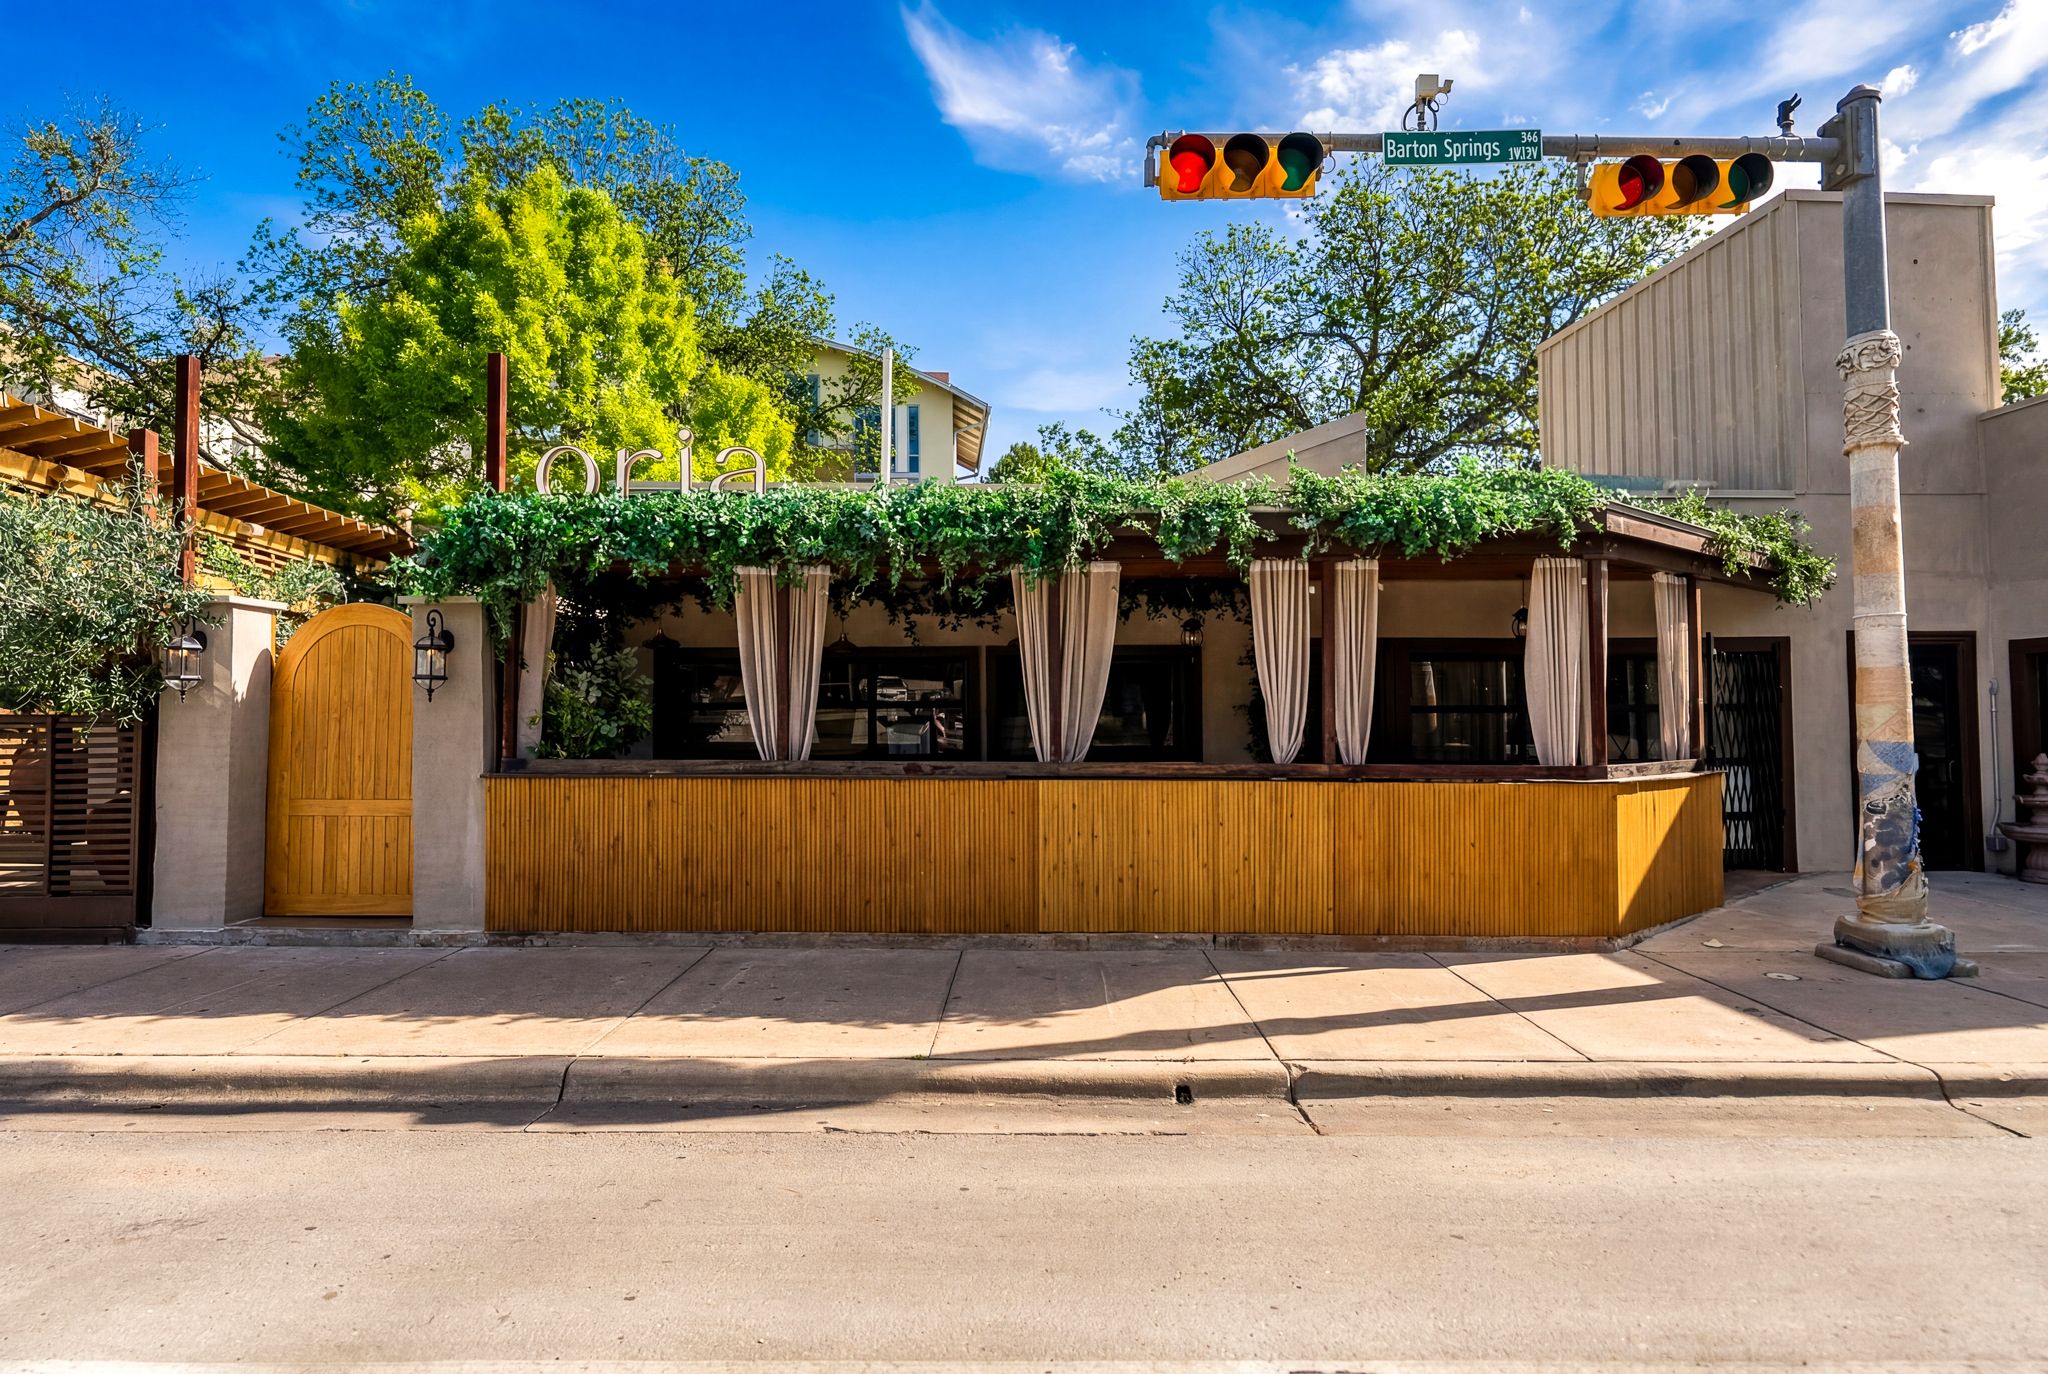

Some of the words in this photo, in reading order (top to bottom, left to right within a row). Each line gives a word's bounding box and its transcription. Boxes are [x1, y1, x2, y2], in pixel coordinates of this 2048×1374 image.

[1386, 139, 1438, 159] Barton
[1443, 138, 1501, 161] Springs
[535, 427, 767, 498] oria
